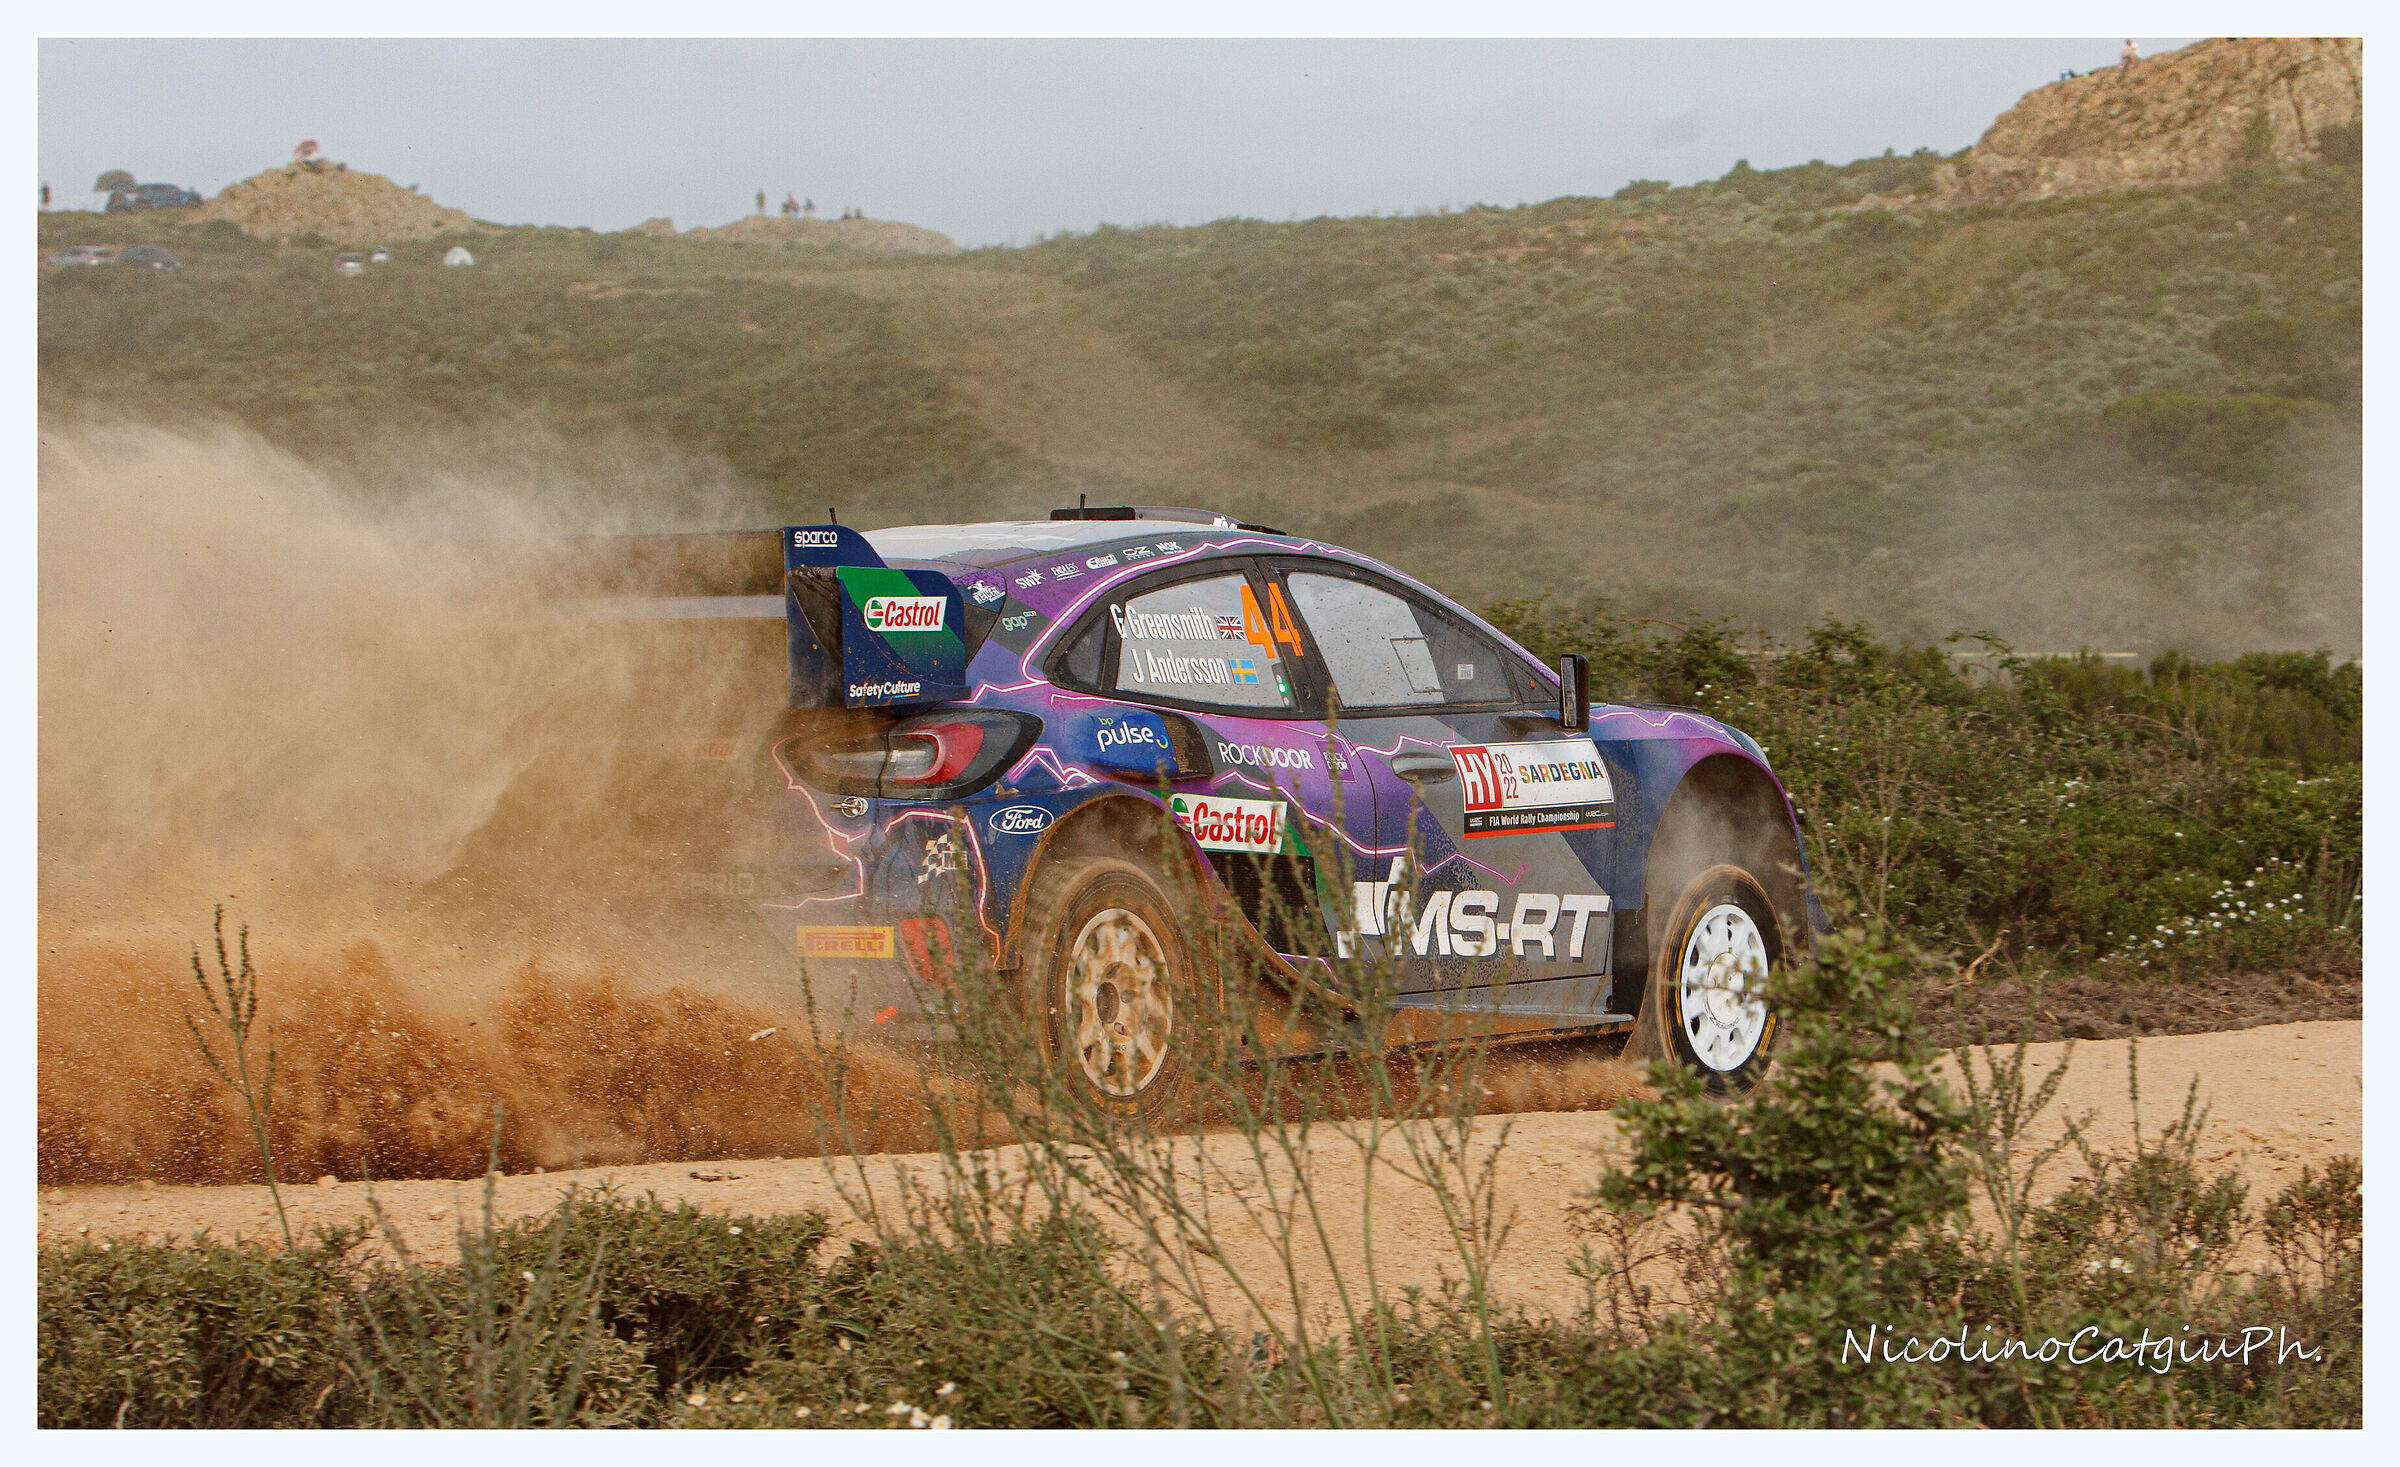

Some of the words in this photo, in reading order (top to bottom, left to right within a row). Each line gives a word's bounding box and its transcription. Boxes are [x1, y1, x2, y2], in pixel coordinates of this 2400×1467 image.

[794, 531, 838, 548] sparco
[1155, 541, 1183, 553] NGK
[1051, 562, 1079, 577] ENDLESS
[1085, 553, 1117, 570] Eibach
[884, 600, 941, 627] Castrol
[1002, 615, 1028, 632] gap
[1110, 603, 1127, 639] G
[1125, 605, 1218, 640] Greensmith
[1240, 582, 1304, 659] 44
[1131, 648, 1145, 684] J
[1145, 648, 1231, 684] Andersson
[849, 680, 921, 699] SafetyCulture
[1098, 716, 1114, 727] bp
[1097, 721, 1155, 752] pulse
[1216, 741, 1315, 770] ROCKDOOR
[1494, 753, 1513, 775] 20
[1518, 760, 1604, 784] SARDEGNA
[1503, 776, 1519, 799] 22
[1001, 808, 1046, 831] Ford
[1193, 801, 1277, 847] Castrol
[1489, 816, 1500, 827] FIA
[1500, 813, 1519, 826] World
[1520, 813, 1537, 826] Rally
[1537, 810, 1580, 825] Championship
